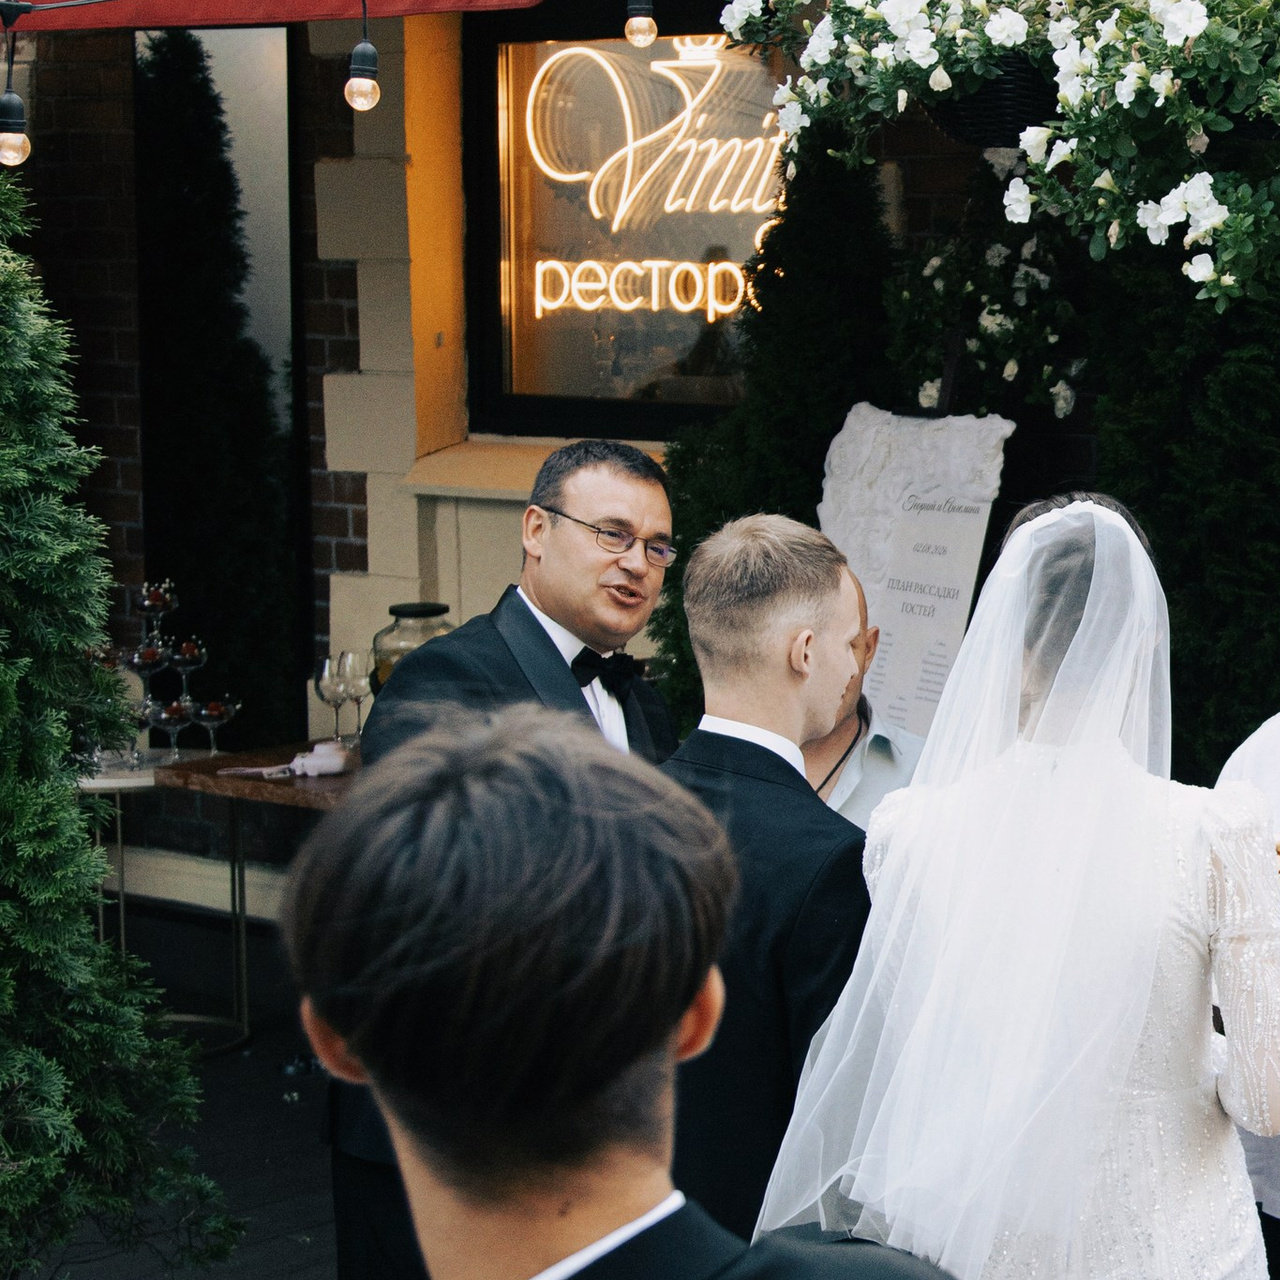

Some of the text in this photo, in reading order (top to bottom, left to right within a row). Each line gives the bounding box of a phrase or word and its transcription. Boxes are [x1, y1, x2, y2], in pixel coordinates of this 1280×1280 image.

[525, 46, 787, 233] Vinit
[535, 259, 763, 324] рестор
[886, 578, 960, 600] ПЛАН РАССАДКИ
[901, 601, 936, 618] ГОСТЕЙ
